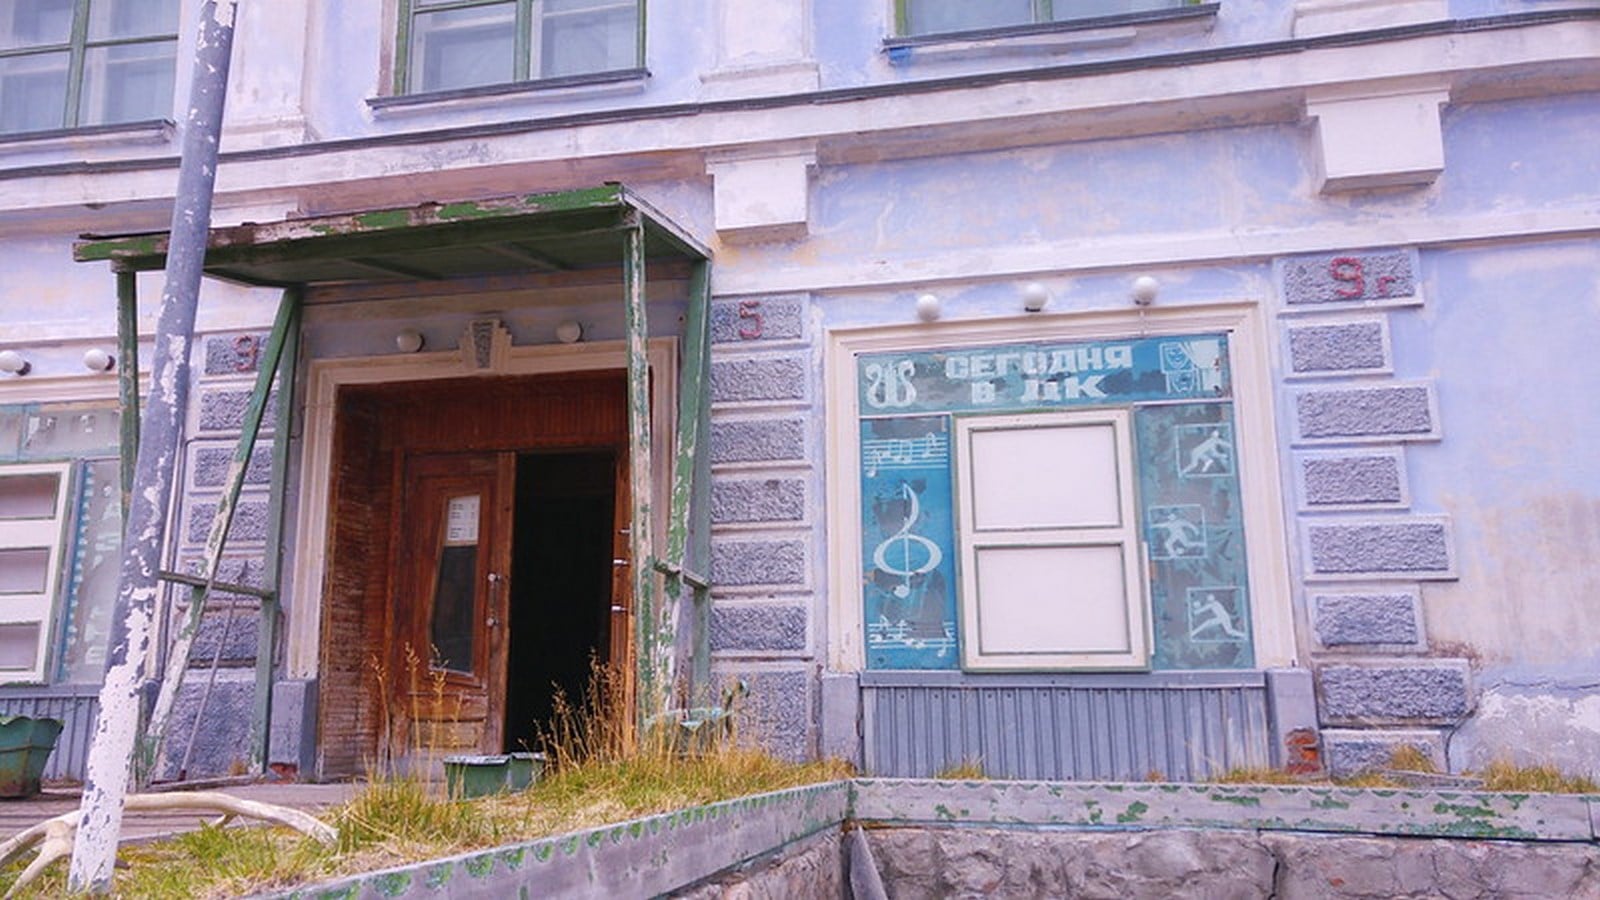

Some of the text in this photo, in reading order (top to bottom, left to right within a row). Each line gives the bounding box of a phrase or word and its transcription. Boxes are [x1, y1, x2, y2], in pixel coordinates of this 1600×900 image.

[739, 300, 764, 338] 5
[232, 335, 258, 373] 9
[945, 346, 1132, 379] СЕГОДНЯ
